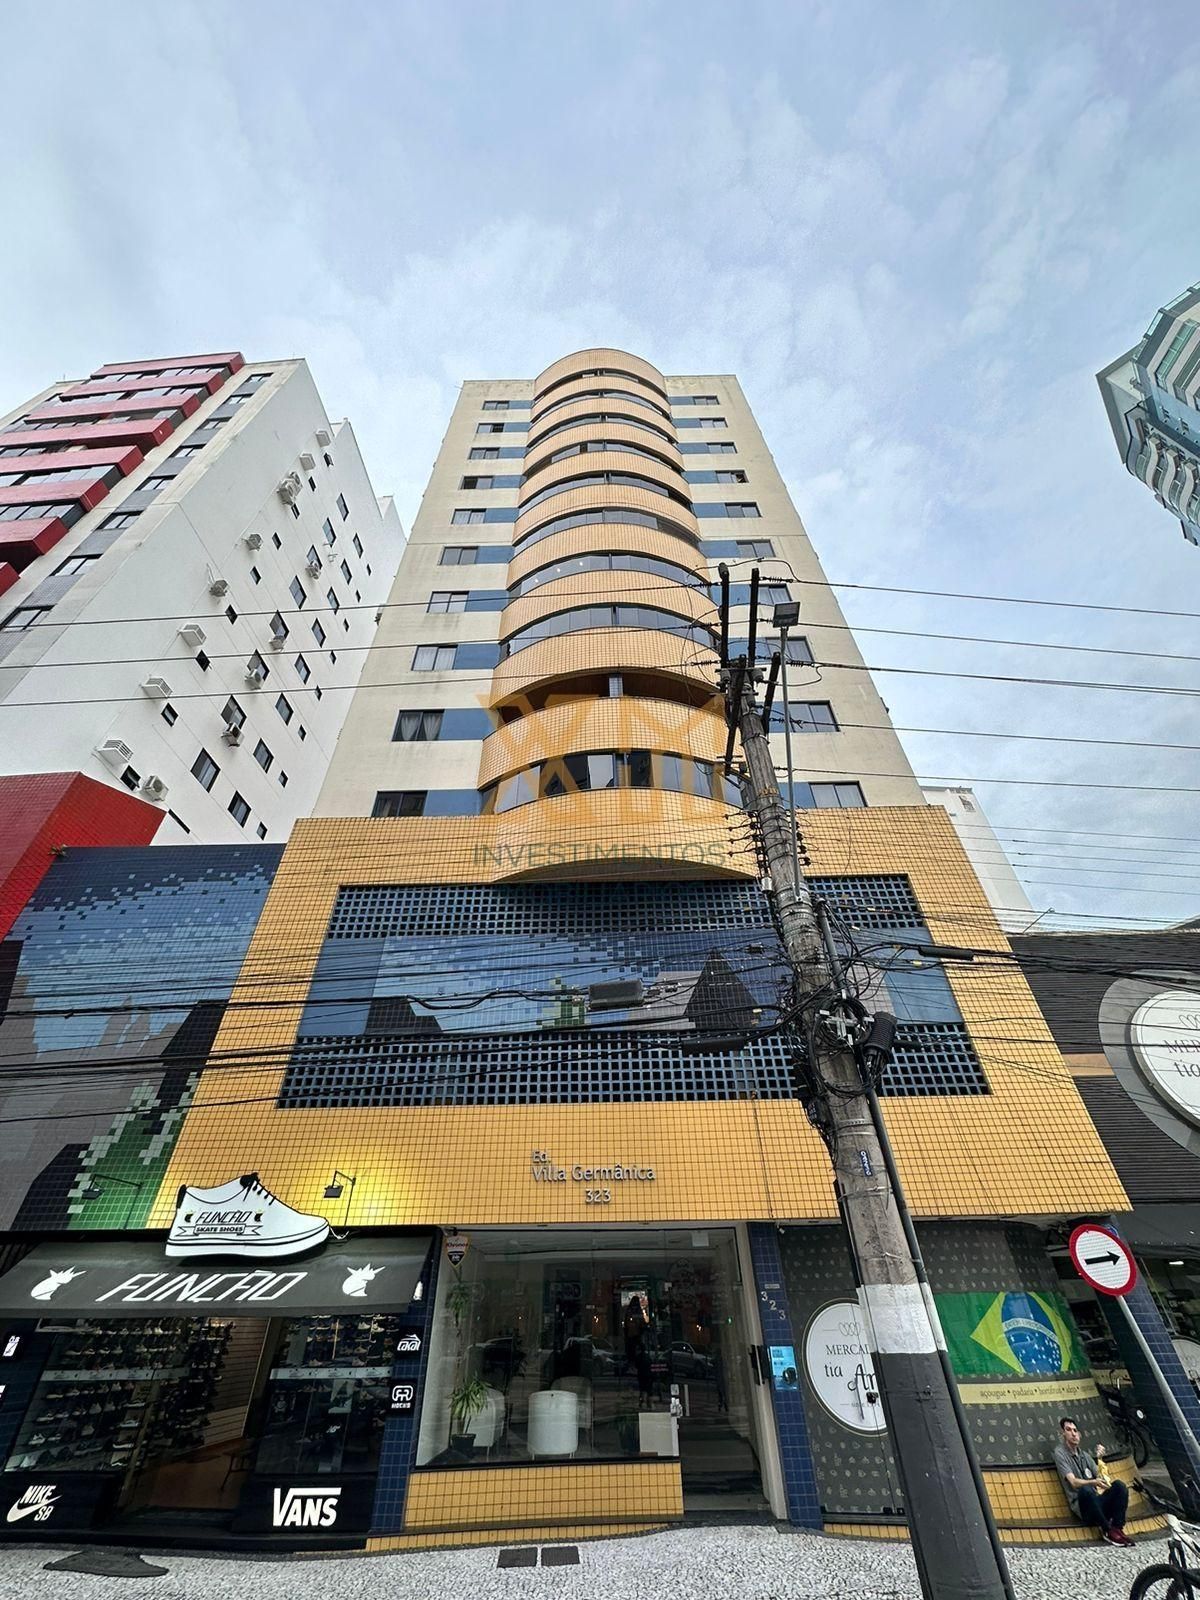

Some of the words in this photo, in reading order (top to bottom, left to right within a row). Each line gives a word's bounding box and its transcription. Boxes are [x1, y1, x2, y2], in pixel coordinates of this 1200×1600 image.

[532, 1165, 567, 1182] Villa
[571, 1163, 657, 1181] Germânica
[585, 1188, 611, 1203] 323
[824, 1361, 843, 1377] tia
[19, 1485, 57, 1504] NIKE
[34, 1506, 54, 1521] SB
[272, 1487, 342, 1527] VANS
